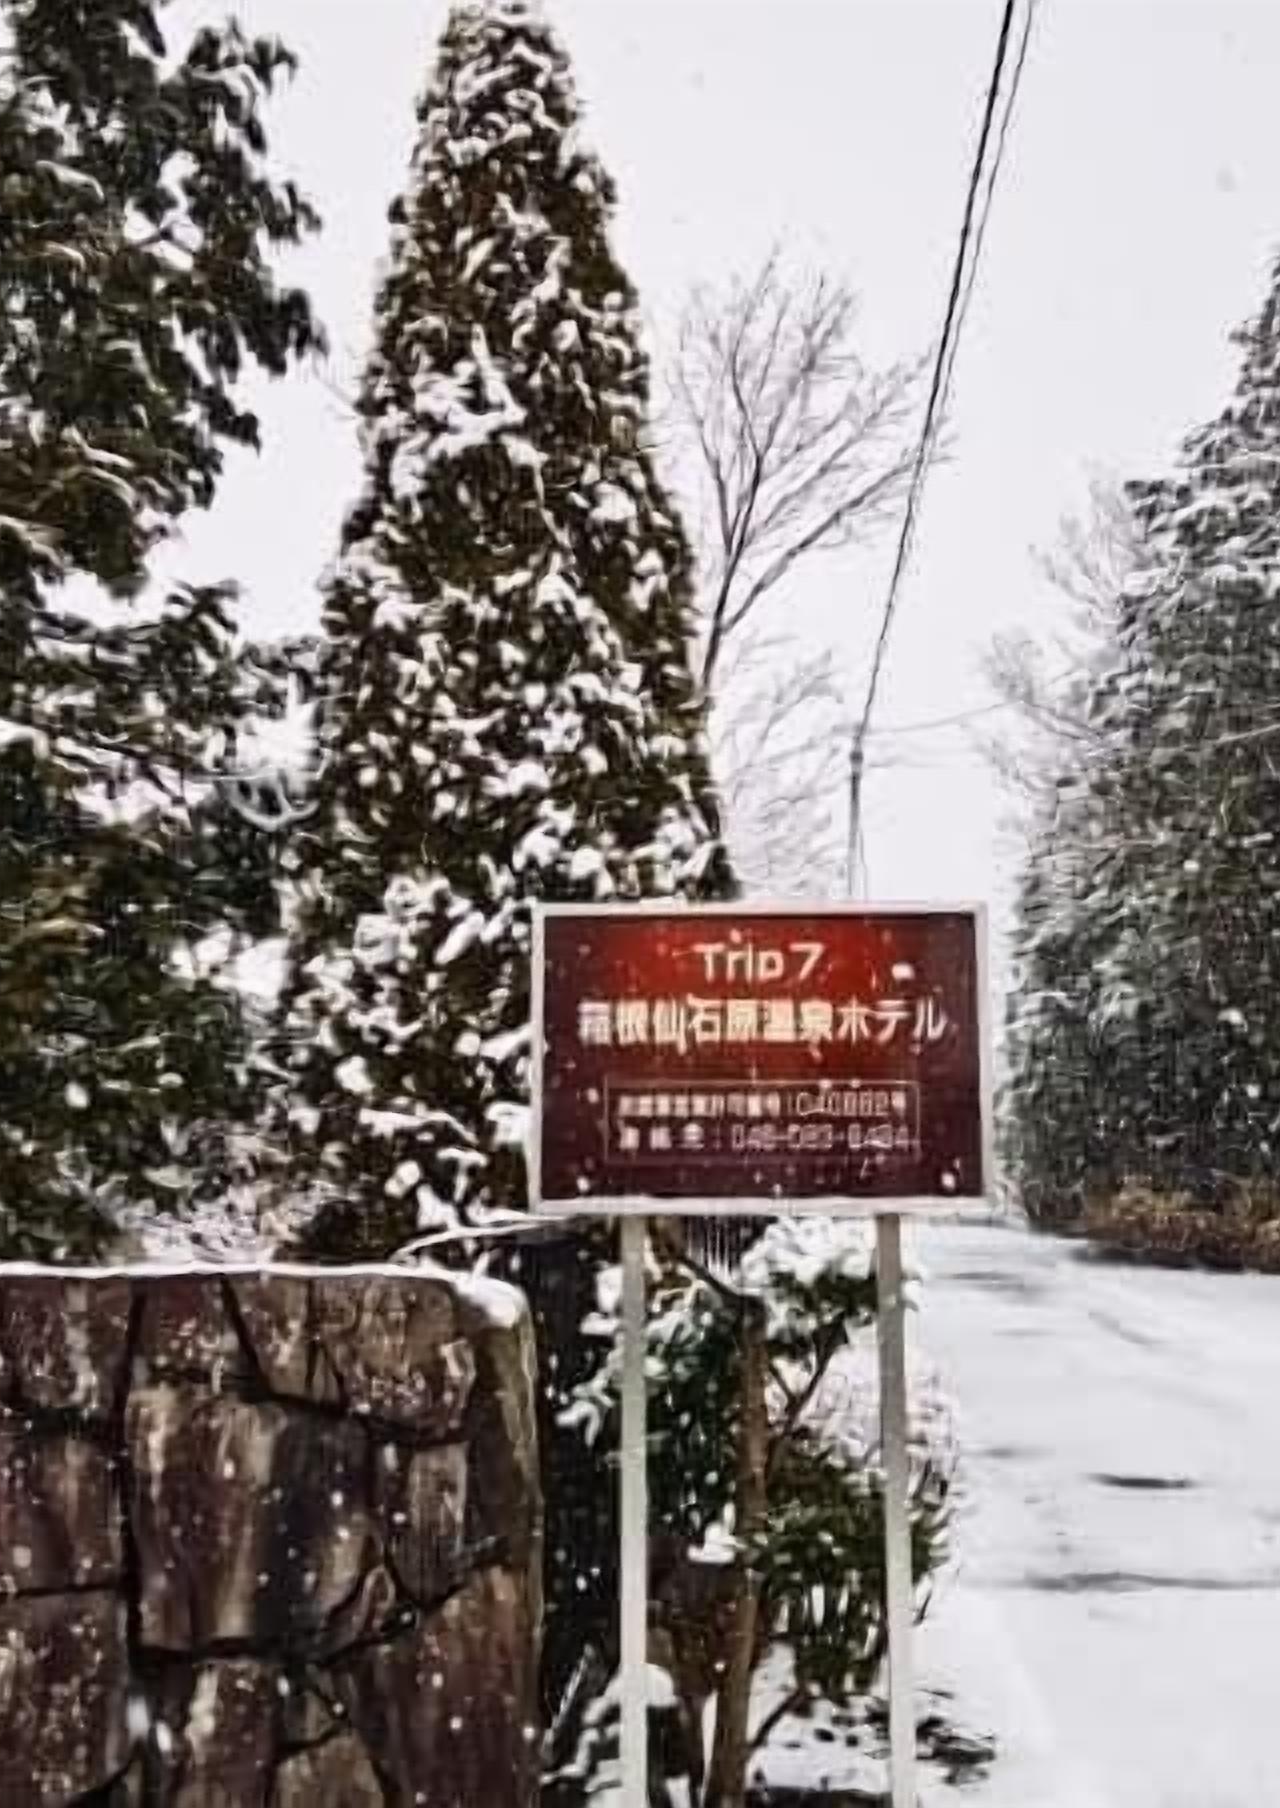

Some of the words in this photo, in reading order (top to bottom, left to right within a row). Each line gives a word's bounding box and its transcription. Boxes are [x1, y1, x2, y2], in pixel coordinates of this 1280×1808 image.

[577, 997, 948, 1045] 箱根仙石原温泉ホテル
